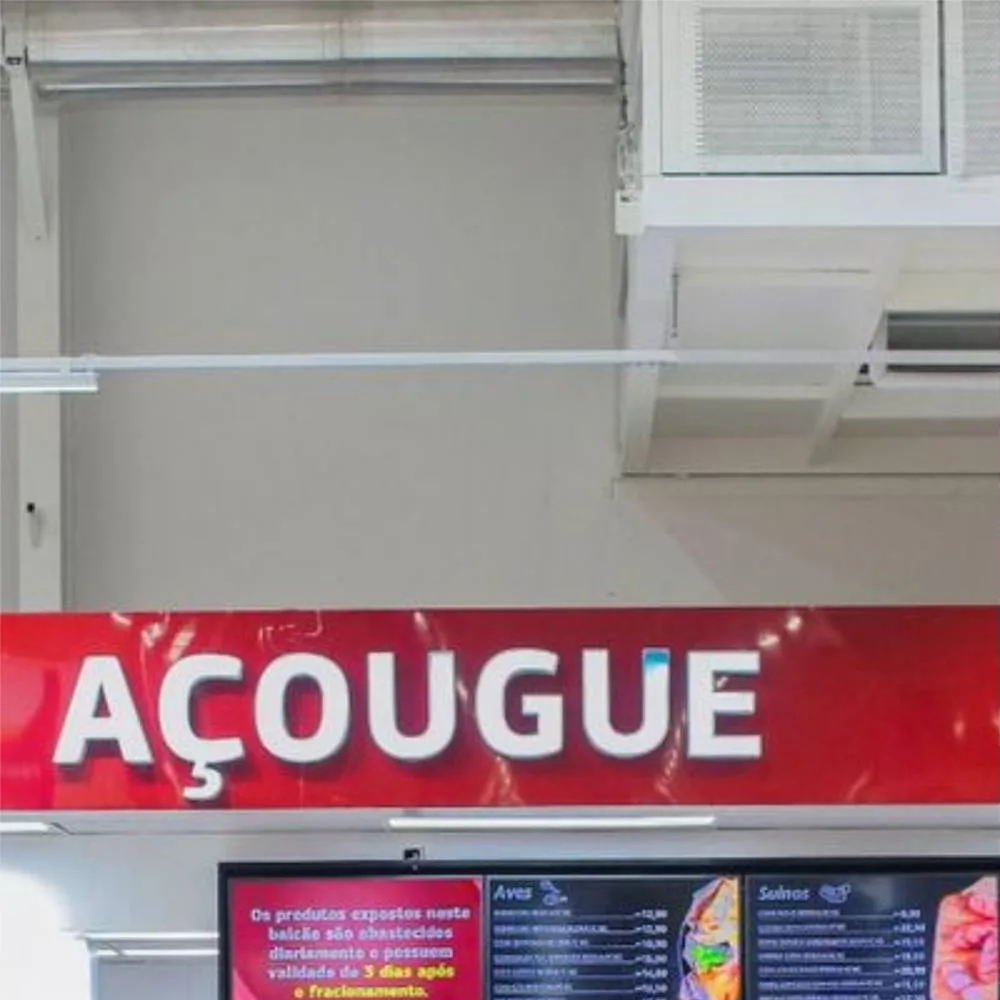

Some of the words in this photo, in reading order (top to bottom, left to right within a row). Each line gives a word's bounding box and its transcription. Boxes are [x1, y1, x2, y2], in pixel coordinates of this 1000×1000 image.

[52, 648, 763, 800] AÇOUGUE
[494, 885, 532, 900] Aves
[251, 908, 271, 921] Os
[276, 907, 346, 923] produtos
[352, 907, 422, 923] expostos
[427, 907, 471, 920] neste
[268, 926, 321, 941] balcão
[326, 927, 354, 941] são
[359, 925, 454, 941] abastecidos
[269, 946, 366, 961] diariamente
[384, 947, 454, 962] possuem
[267, 965, 335, 979] validade
[340, 965, 359, 979] de
[364, 965, 375, 979] 3
[379, 964, 412, 979] dias
[416, 963, 455, 980] após
[293, 987, 305, 998] o
[309, 984, 429, 998] fracionamento.
